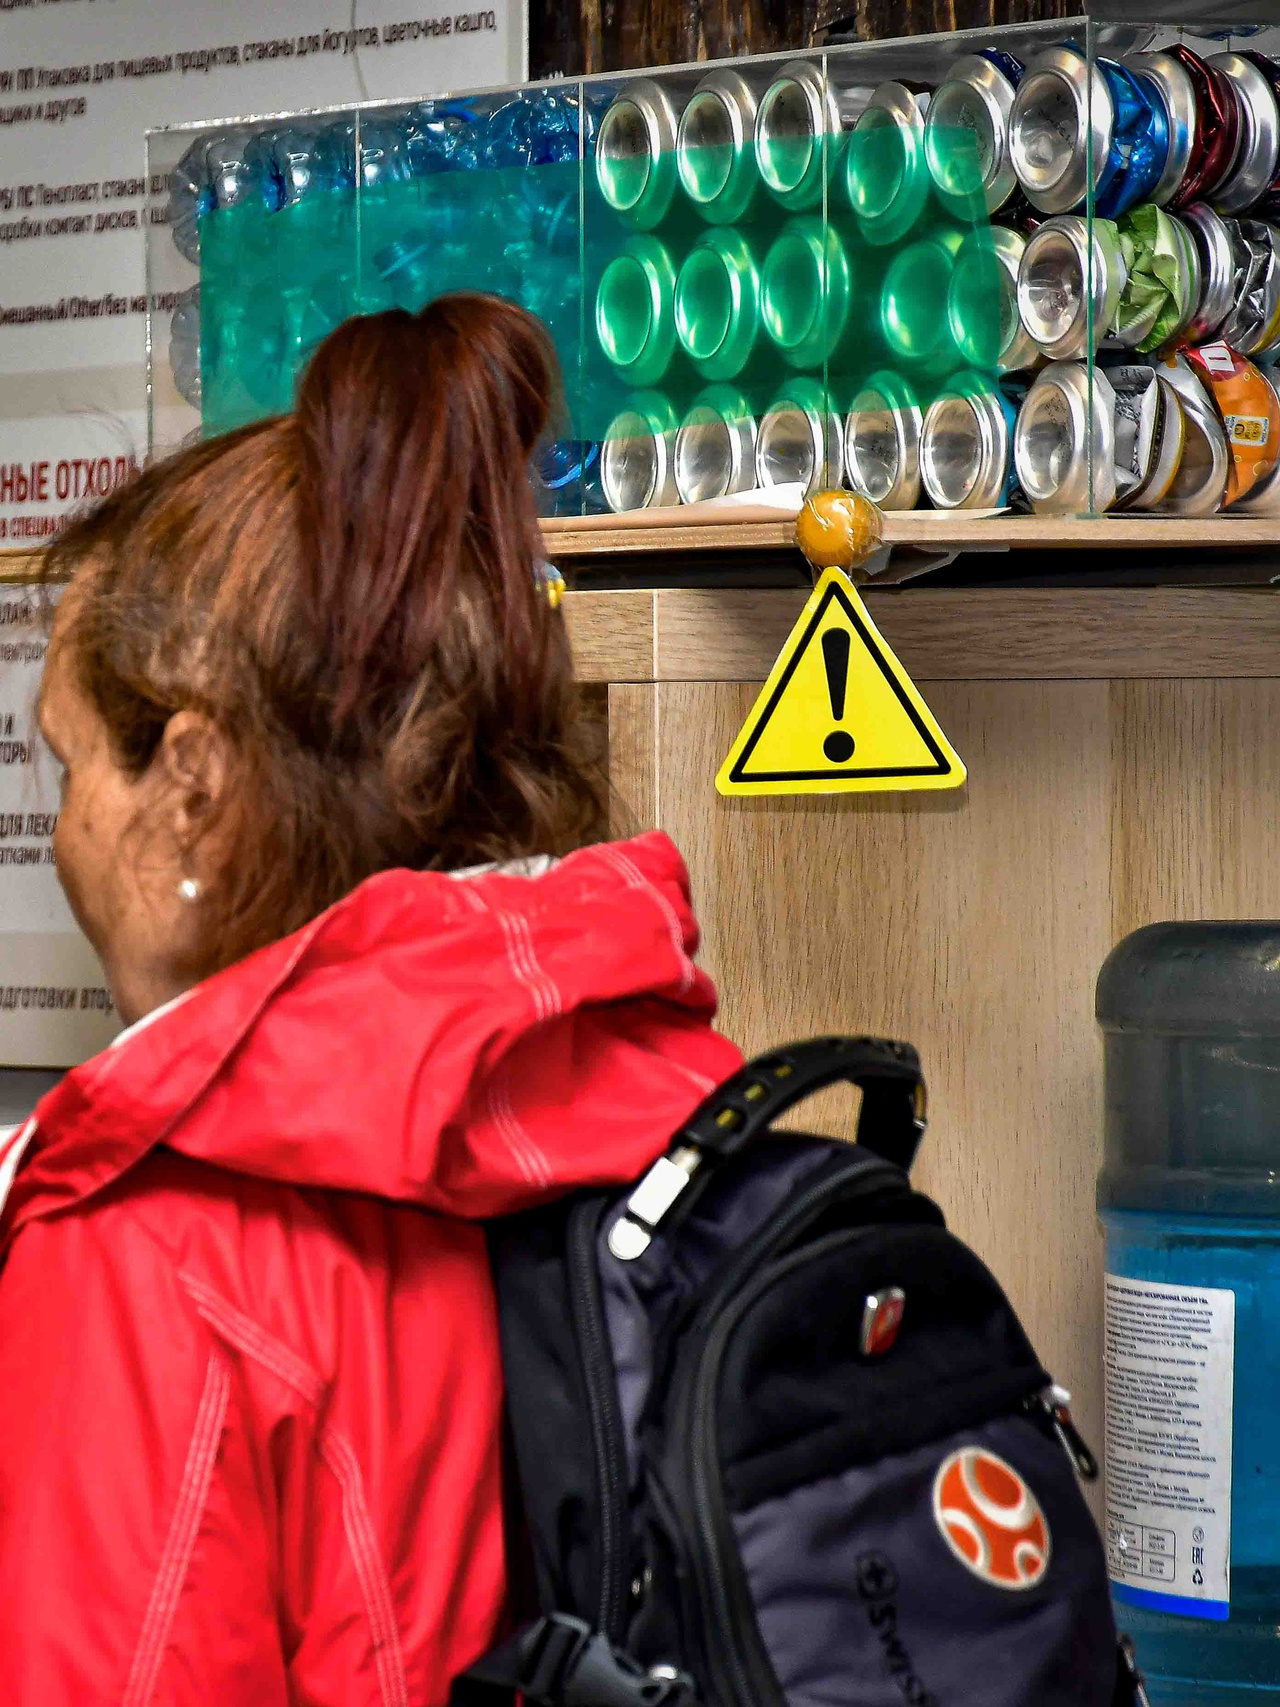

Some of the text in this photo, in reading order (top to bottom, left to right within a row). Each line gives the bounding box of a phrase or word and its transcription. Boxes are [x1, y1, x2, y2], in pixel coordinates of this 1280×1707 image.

[242, 41, 295, 62] стаканы
[296, 34, 320, 57] для
[382, 15, 451, 44] цветочные
[454, 9, 497, 32] кашпо,
[102, 177, 148, 199] стакан
[10, 514, 69, 540] СПЕЦИАЛ
[4, 713, 14, 737] И
